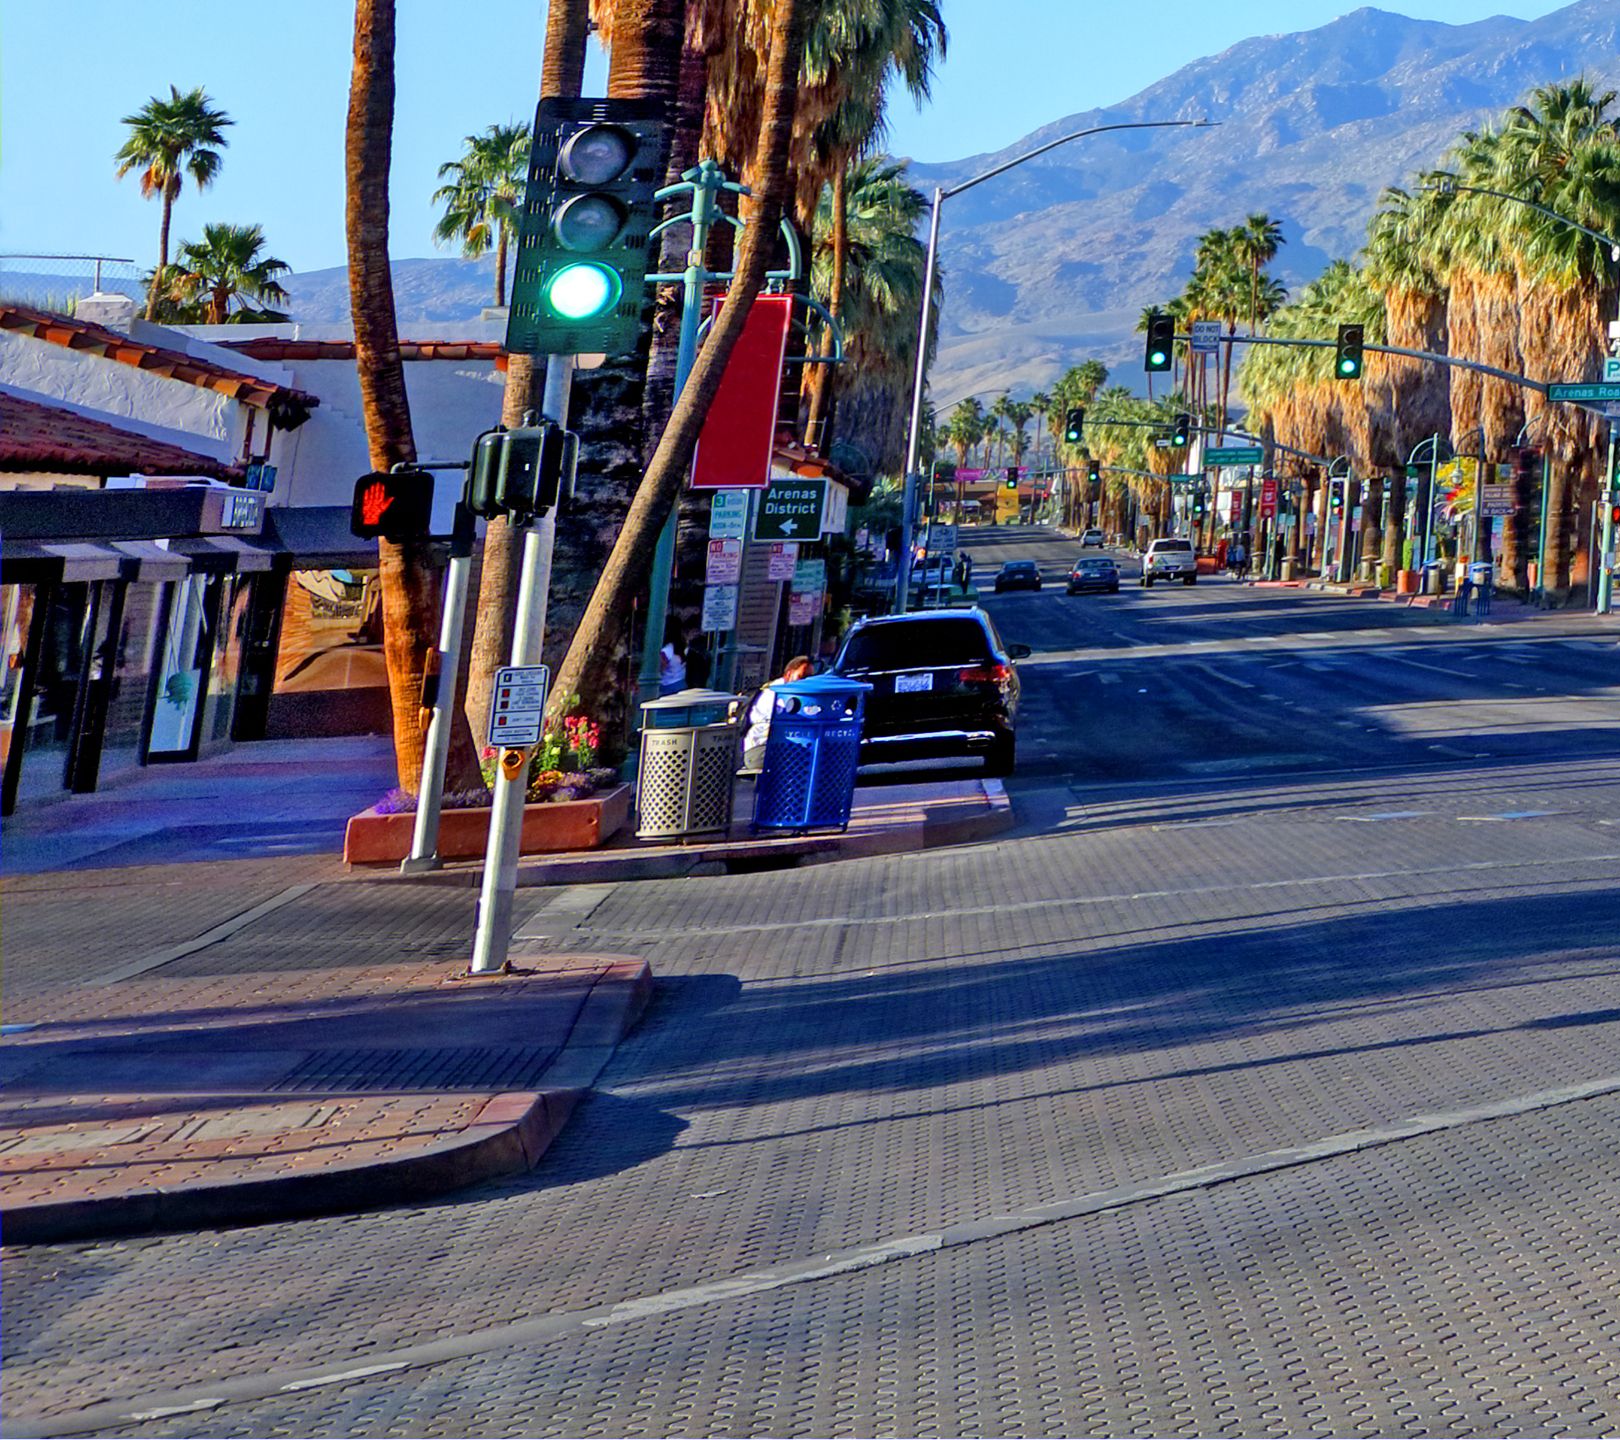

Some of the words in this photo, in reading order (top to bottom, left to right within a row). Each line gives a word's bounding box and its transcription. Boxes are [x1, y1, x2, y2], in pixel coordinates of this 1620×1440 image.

[1554, 388, 1594, 397] Arenas
[767, 488, 817, 500] Arenas
[765, 503, 816, 514] District
